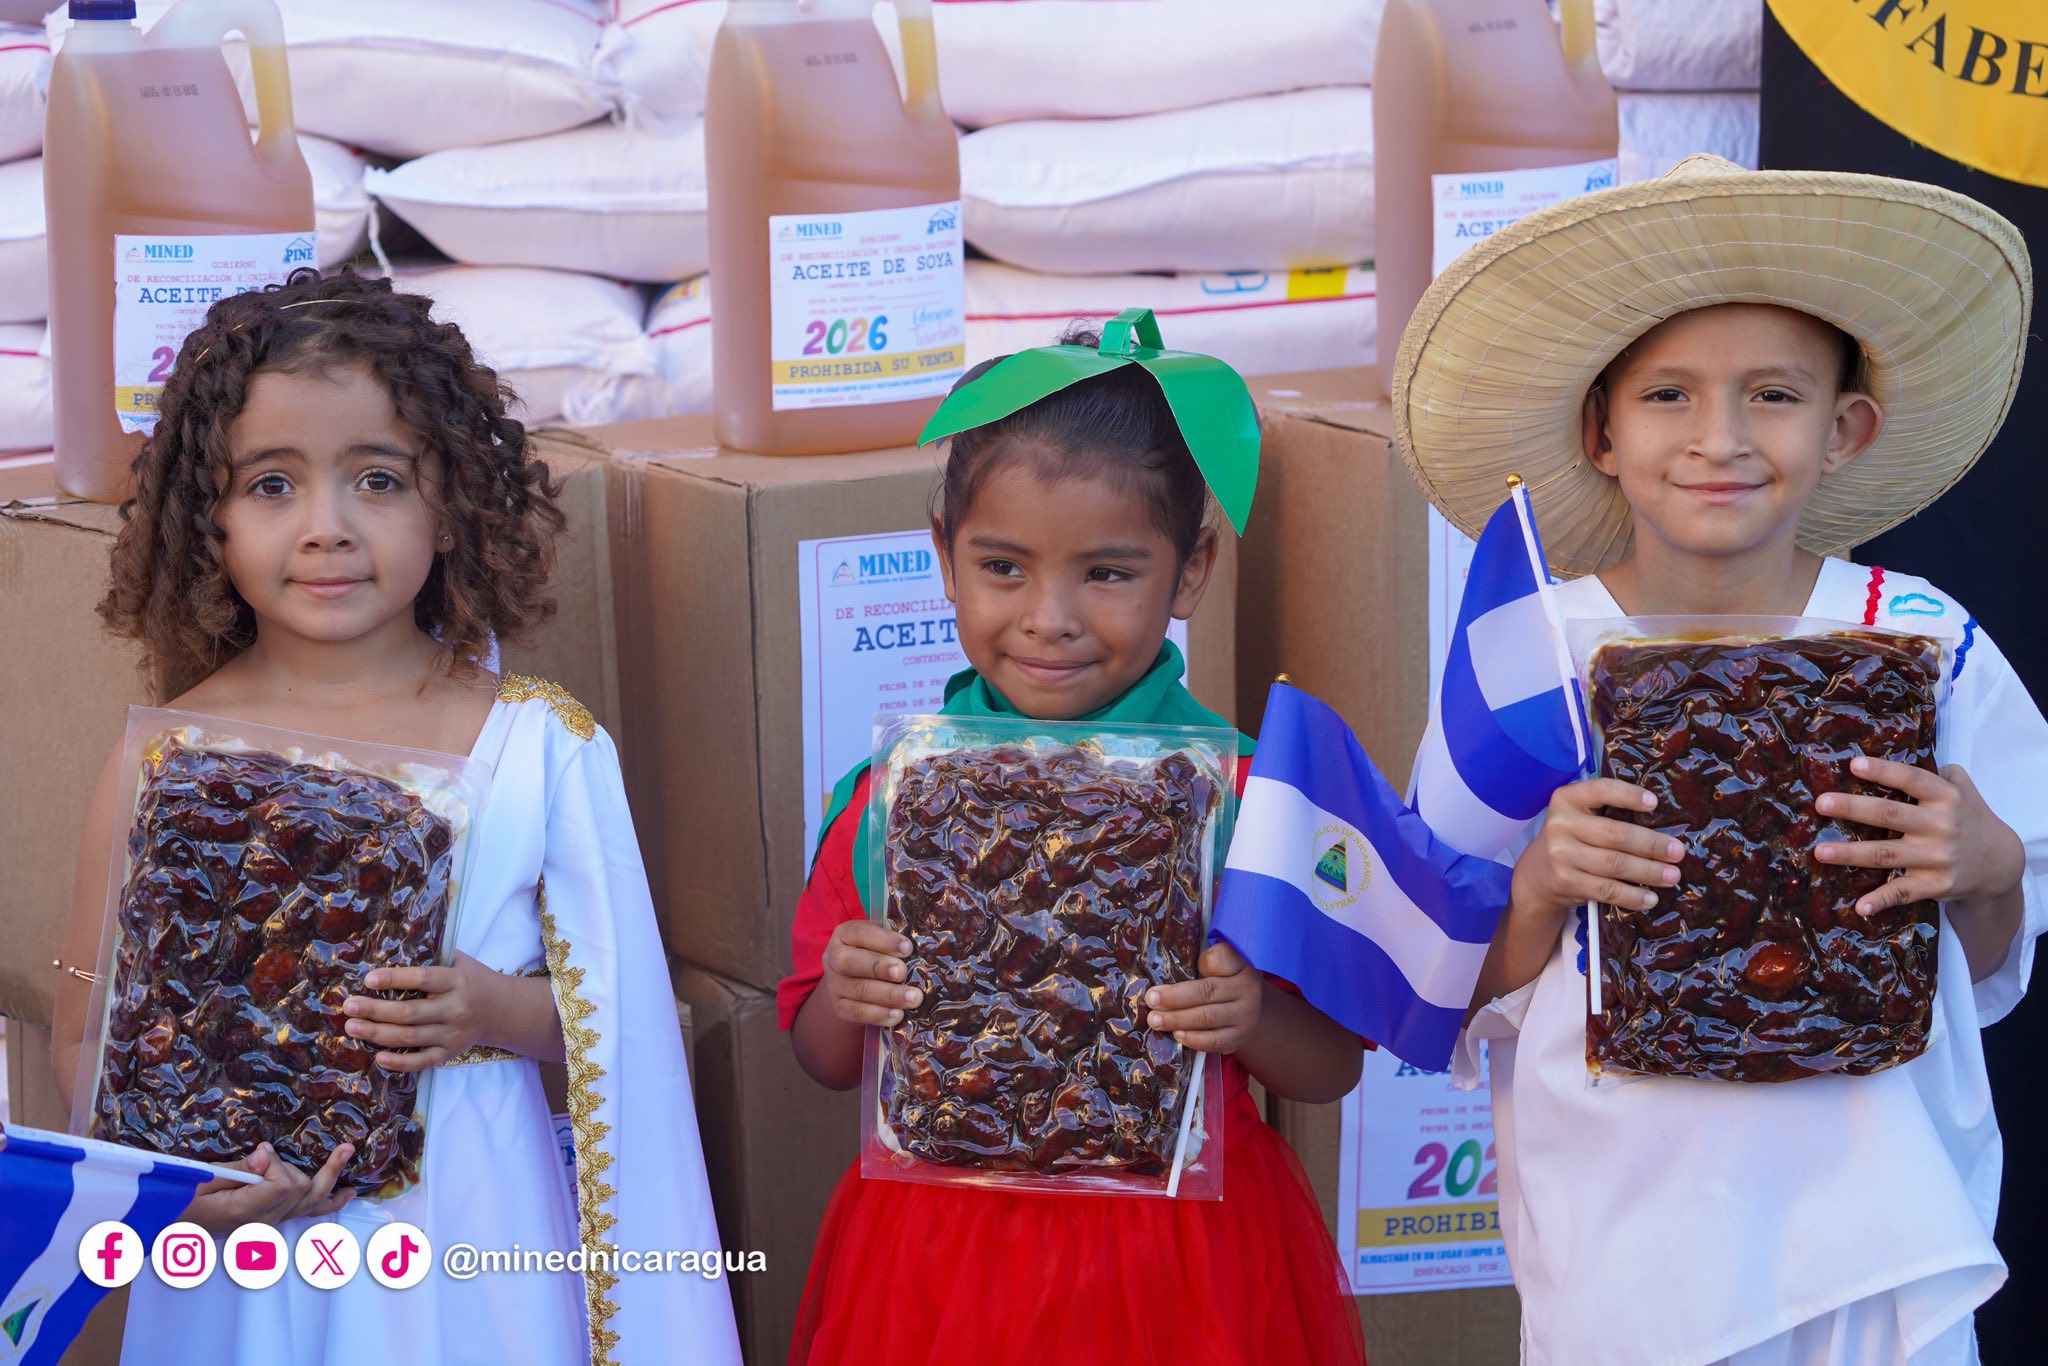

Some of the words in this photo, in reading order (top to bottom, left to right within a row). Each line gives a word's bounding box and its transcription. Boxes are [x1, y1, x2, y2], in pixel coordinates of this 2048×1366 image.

[1857, 0, 2048, 98] FABE
[1460, 181, 1504, 195] MINED
[796, 222, 843, 237] MINED
[144, 244, 194, 259] MINED
[284, 247, 313, 263] PINE
[792, 261, 871, 280] ACEITE
[883, 258, 905, 274] DE
[916, 252, 953, 271] SOYA
[138, 287, 222, 304] ACEITE
[802, 314, 888, 356] 2026
[789, 361, 883, 379] PROHIBIDA
[892, 357, 910, 372] SU
[918, 351, 955, 368] VENTA
[858, 549, 932, 578] MINED
[836, 607, 854, 621] DE
[853, 618, 958, 652] ACEIT
[1384, 1210, 1500, 1237] PROHIBI
